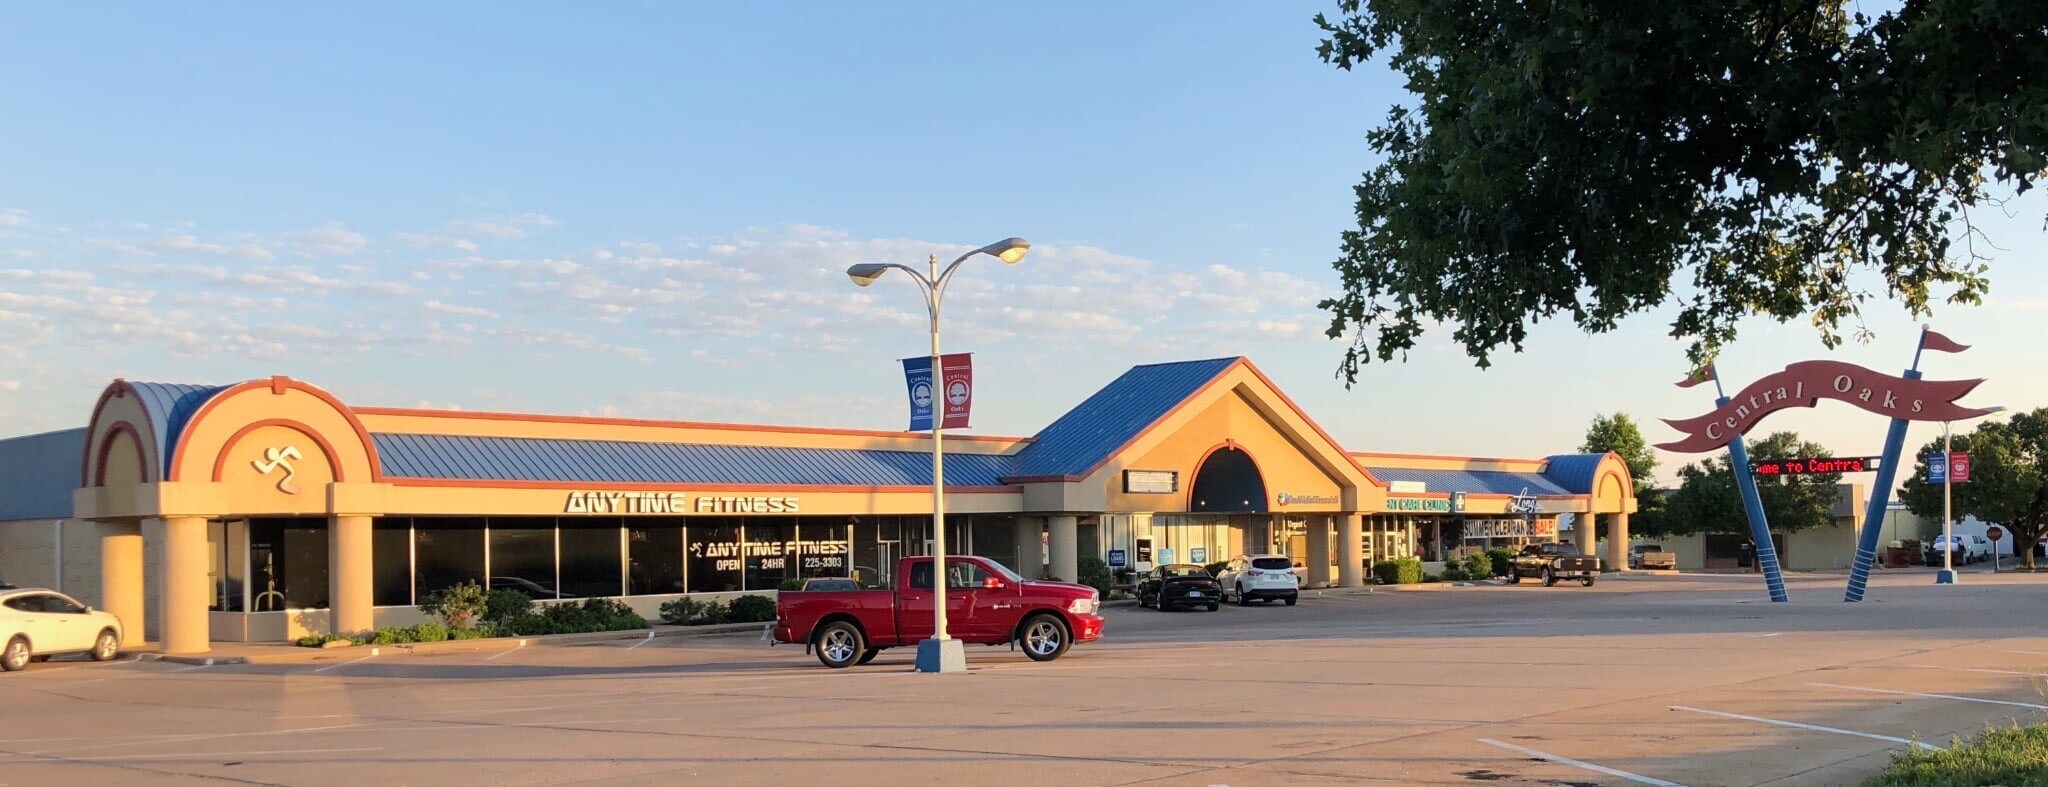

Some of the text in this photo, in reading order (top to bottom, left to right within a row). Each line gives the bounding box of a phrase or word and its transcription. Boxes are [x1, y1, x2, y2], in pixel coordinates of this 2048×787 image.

[946, 373, 969, 381] Central
[1706, 374, 1923, 440] Central Oaks
[1786, 462, 1803, 473] to
[1809, 457, 1864, 473] Centra
[563, 490, 800, 513] ANYTIME FITNESS
[1464, 519, 1493, 537] SUMMER
[1535, 519, 1553, 535] SALE
[706, 540, 848, 557] ANYTIME FITNESS
[716, 557, 842, 571] OPEN 24HR 225-3303
